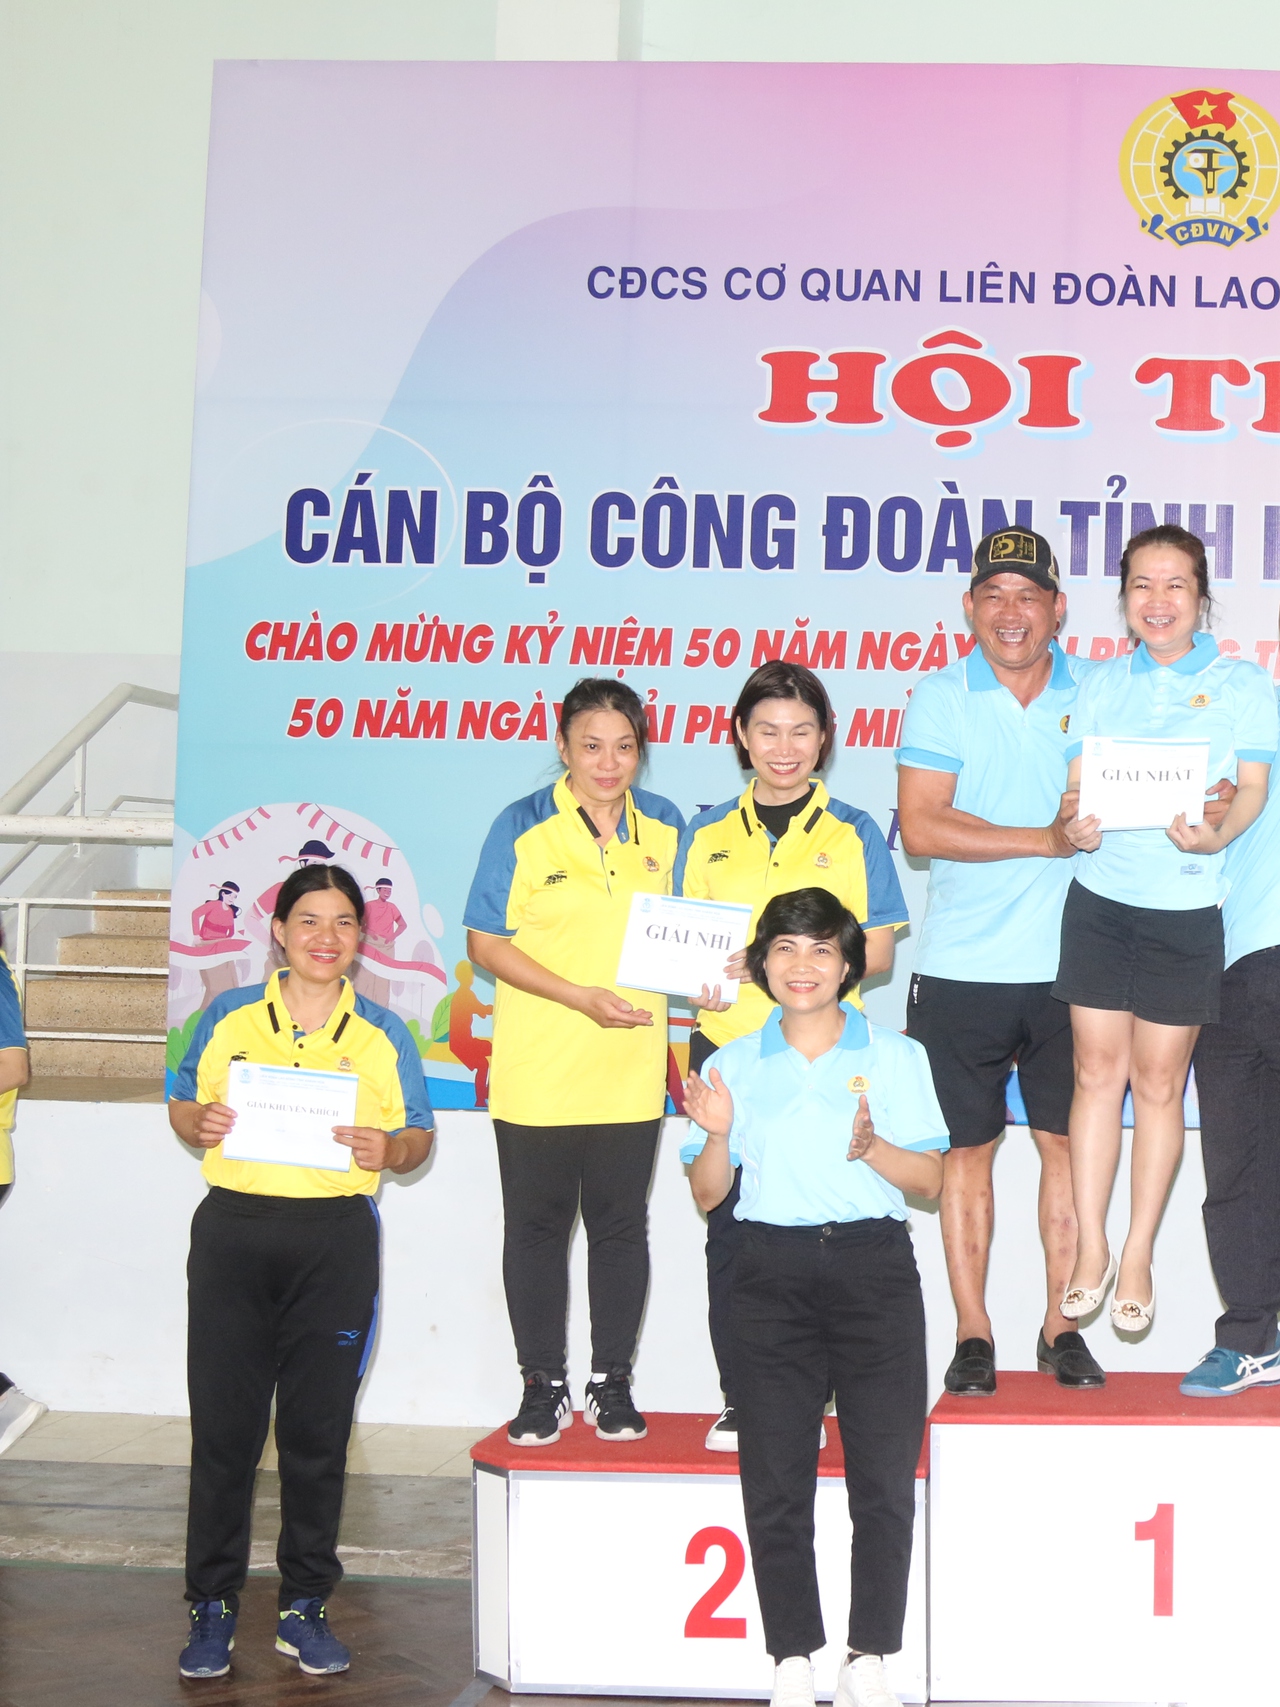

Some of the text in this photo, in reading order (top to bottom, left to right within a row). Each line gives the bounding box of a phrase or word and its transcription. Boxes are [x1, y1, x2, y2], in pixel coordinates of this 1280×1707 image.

[1175, 222, 1235, 242] CĐVN
[587, 265, 708, 301] CĐCS
[724, 263, 786, 301] CƠ
[800, 267, 921, 303] QUAN
[939, 261, 1036, 304] LIÊN
[1053, 264, 1176, 307] ĐOÀN
[1195, 275, 1280, 310] LAO
[758, 329, 1082, 448] HỘI
[285, 473, 438, 566] CÁN
[465, 475, 562, 584] BỘ
[591, 476, 797, 571] CÔNG
[822, 481, 1033, 574] ĐOÀN
[245, 611, 358, 662] CHÀO
[365, 613, 494, 664] MỪNG
[504, 610, 564, 665] KỶ
[569, 616, 673, 678] NIỆM
[683, 628, 741, 669] 50
[750, 617, 847, 669] NĂM
[287, 698, 344, 739] 50
[353, 687, 448, 740] NĂM
[695, 931, 732, 951] NHÌ
[683, 1525, 747, 1639] 2
[1135, 1503, 1174, 1617] 1
